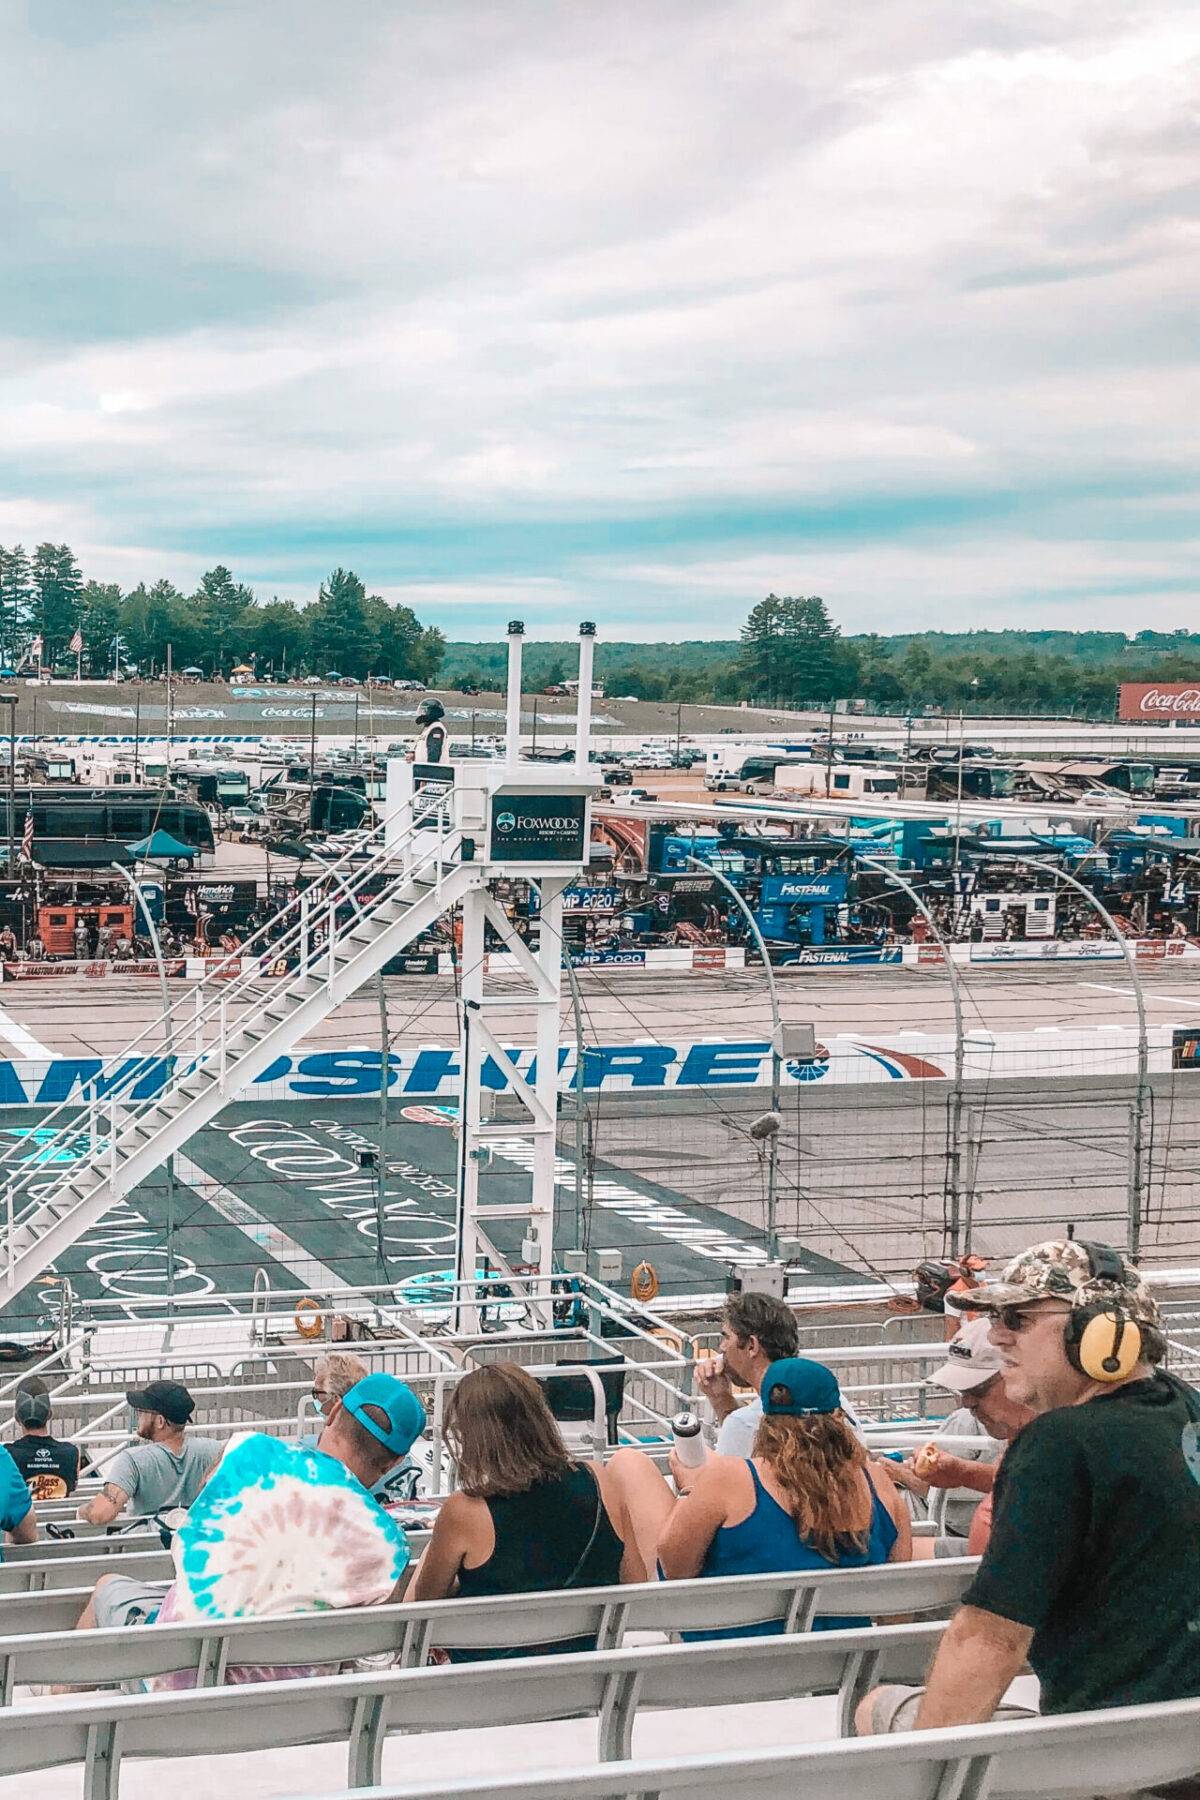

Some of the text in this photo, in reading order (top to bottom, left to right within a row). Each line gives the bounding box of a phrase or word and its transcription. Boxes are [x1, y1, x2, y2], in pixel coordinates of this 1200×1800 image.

[517, 816, 580, 829] FOXWOODS
[195, 884, 236, 894] Hendrick
[780, 882, 833, 896] FASTENAL
[1161, 881, 1186, 905] 14
[583, 891, 612, 908] 2020
[604, 956, 642, 967] 2020
[800, 950, 851, 964] FASTENAL
[37, 1475, 60, 1487] Bass
